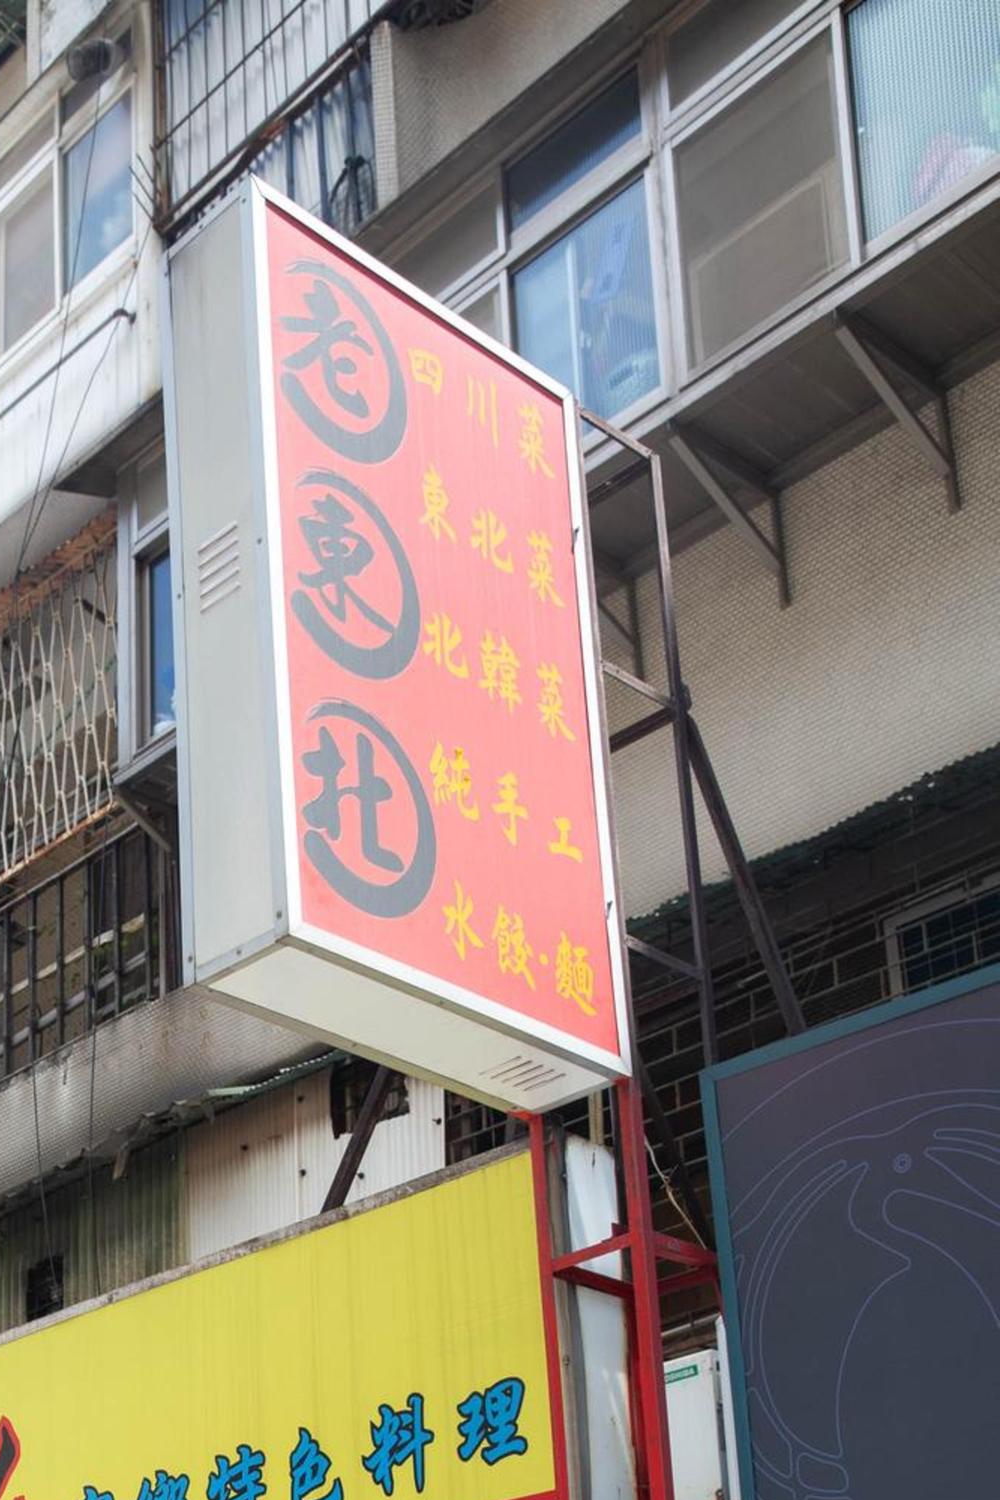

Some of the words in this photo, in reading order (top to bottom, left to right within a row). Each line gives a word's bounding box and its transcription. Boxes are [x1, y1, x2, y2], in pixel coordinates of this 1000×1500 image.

[408, 348, 555, 479] 四川菜
[419, 458, 566, 608] 東北菜
[422, 612, 577, 742] 北韓菜
[428, 740, 584, 864] 純手工
